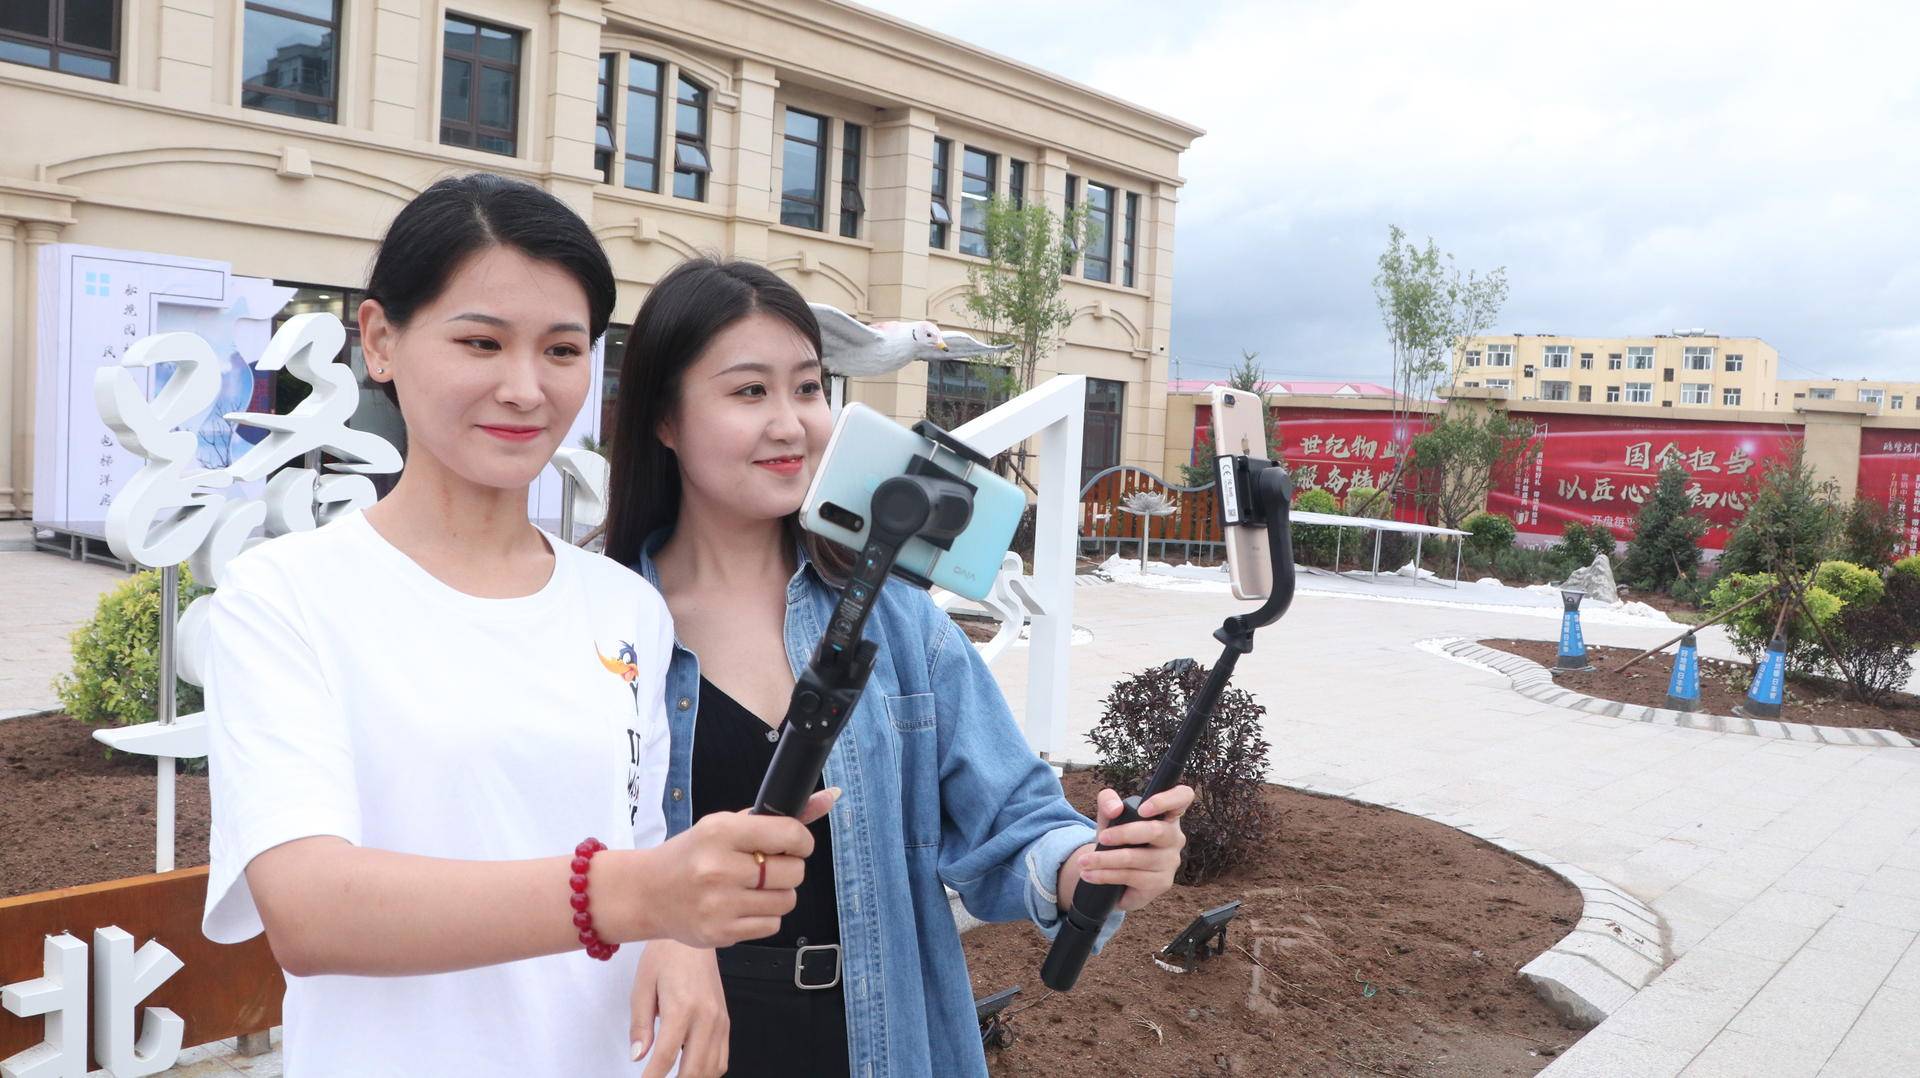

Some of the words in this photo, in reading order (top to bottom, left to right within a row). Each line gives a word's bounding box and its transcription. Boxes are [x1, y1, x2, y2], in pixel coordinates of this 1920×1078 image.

[1624, 441, 1755, 476] 国企担当
[1558, 475, 1762, 512] 以匠心初心
[952, 565, 977, 583] vivo
[0, 924, 185, 1078] 北
